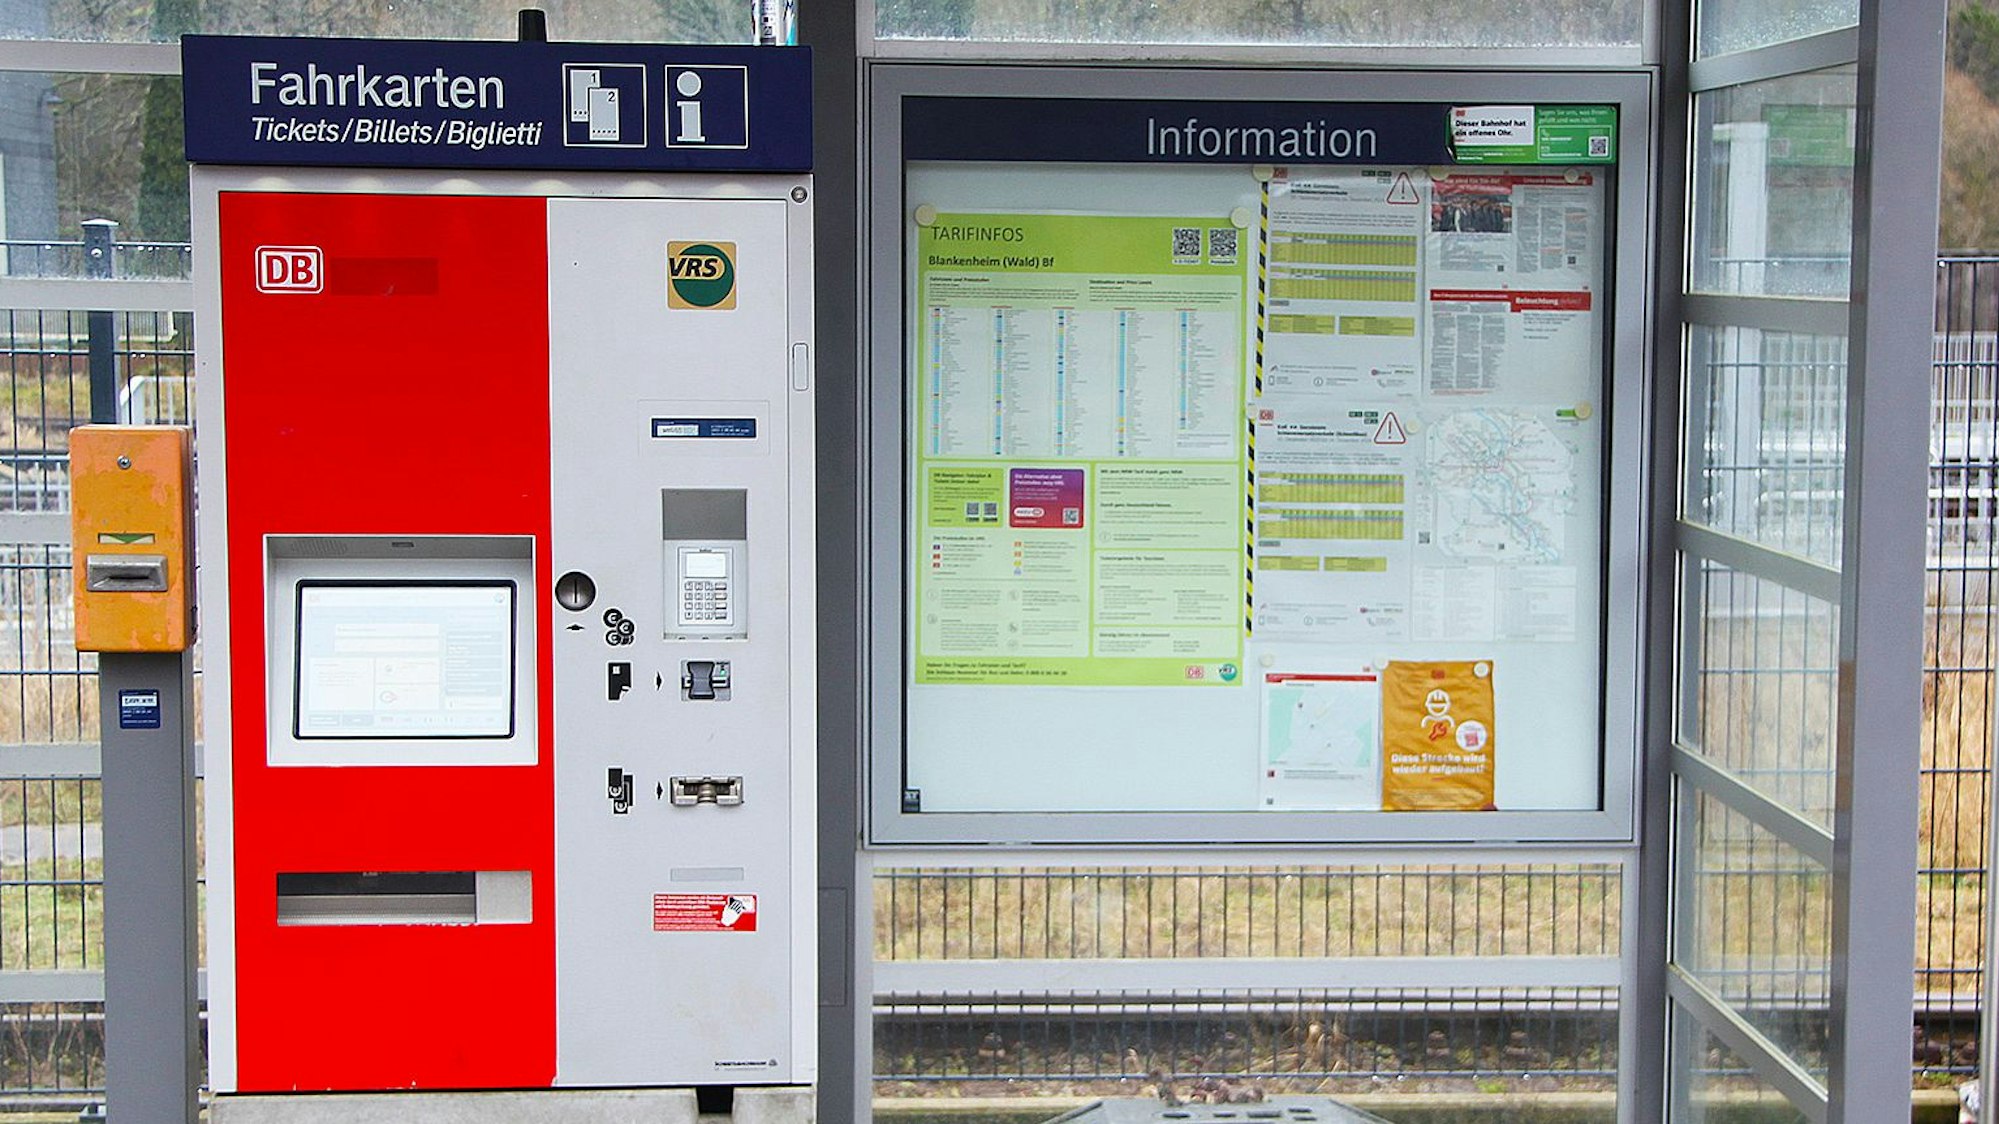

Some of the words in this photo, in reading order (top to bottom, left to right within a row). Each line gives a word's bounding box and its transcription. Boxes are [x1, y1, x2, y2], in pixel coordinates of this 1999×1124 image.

[250, 61, 505, 109] Fahrkarten
[606, 91, 617, 103] 2
[1455, 119, 1479, 127] Dieser
[1480, 119, 1512, 127] Bahnhof
[1147, 117, 1377, 158] Information
[930, 226, 1024, 242] TARIFINFOS
[668, 256, 719, 279] VRS
[928, 255, 1001, 267] Blankenheim
[1002, 256, 1040, 269] (Wald)
[264, 255, 315, 287] DB
[1391, 753, 1419, 763] Diese
[1463, 753, 1487, 763] wird
[1392, 764, 1426, 773] wieder
